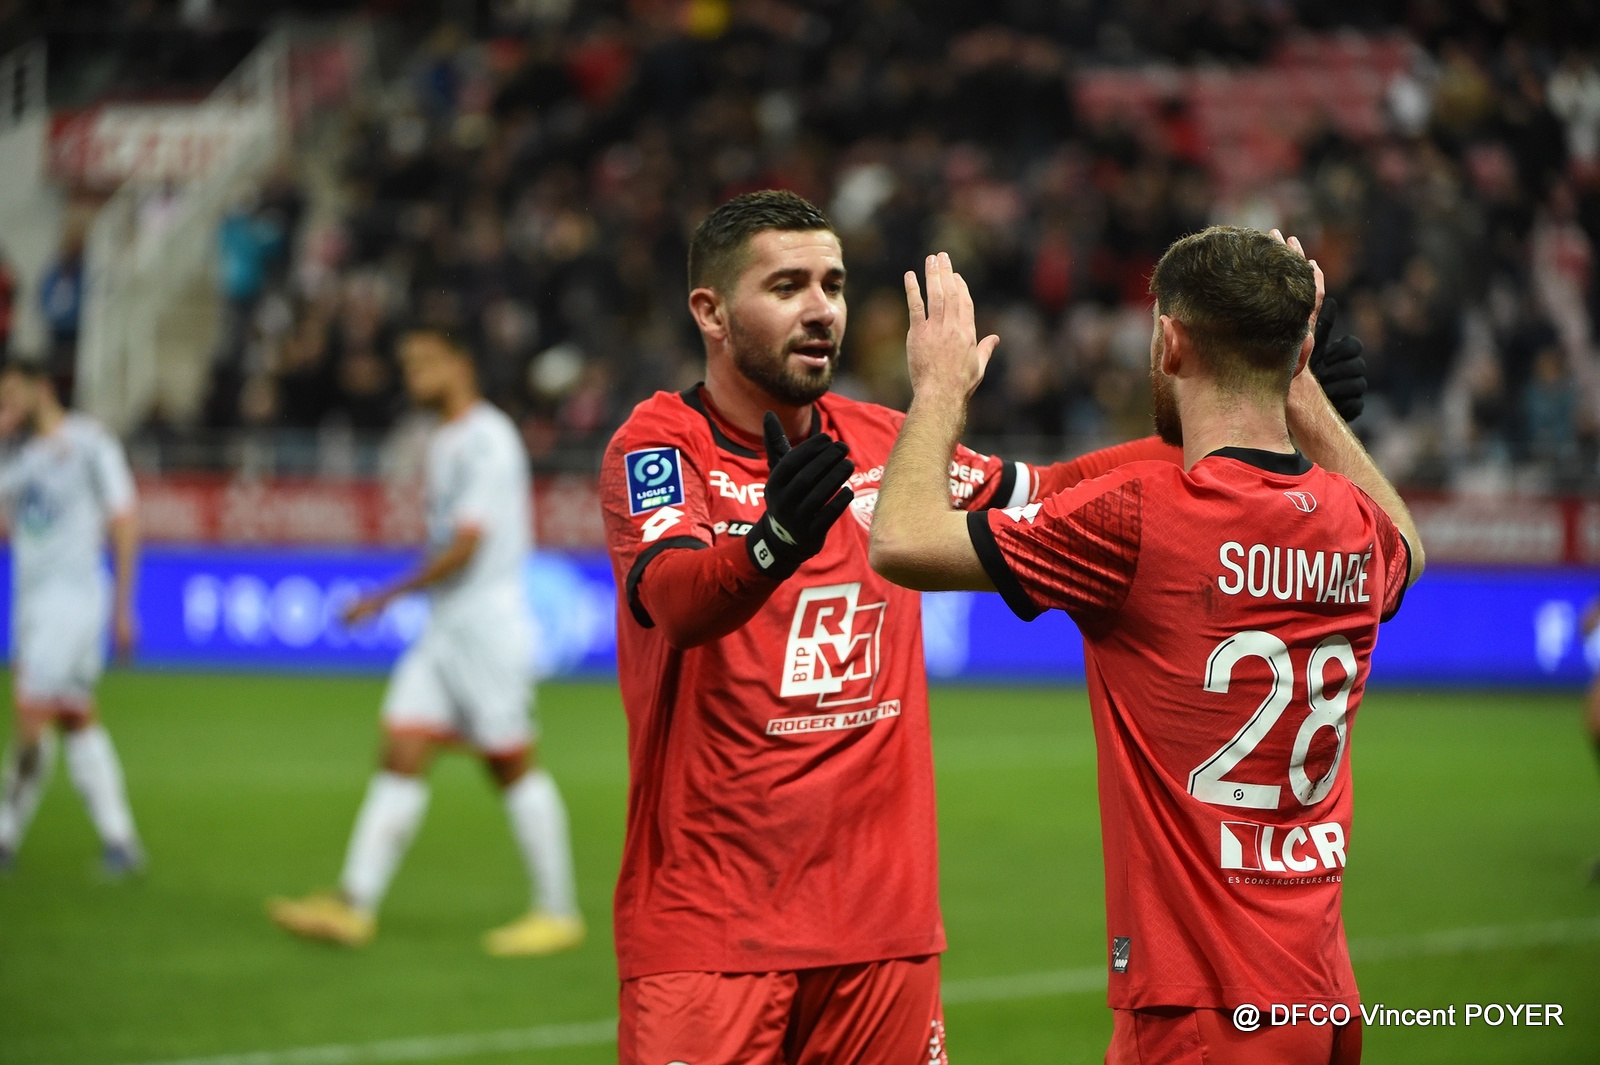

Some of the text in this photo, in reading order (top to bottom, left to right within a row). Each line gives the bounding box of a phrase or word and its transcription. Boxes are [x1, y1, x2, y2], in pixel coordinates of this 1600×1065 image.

[948, 461, 985, 485] DER
[637, 487, 668, 500] LIGUE
[728, 523, 754, 536] LO
[1217, 541, 1374, 604] SOUMARÉ
[792, 646, 811, 684] BTP
[769, 716, 836, 733] ROGER
[1186, 630, 1358, 810] 28
[1261, 822, 1347, 872] LCR
[1244, 876, 1323, 885] CONSTRUCTEURS
[1325, 875, 1342, 883] REU
